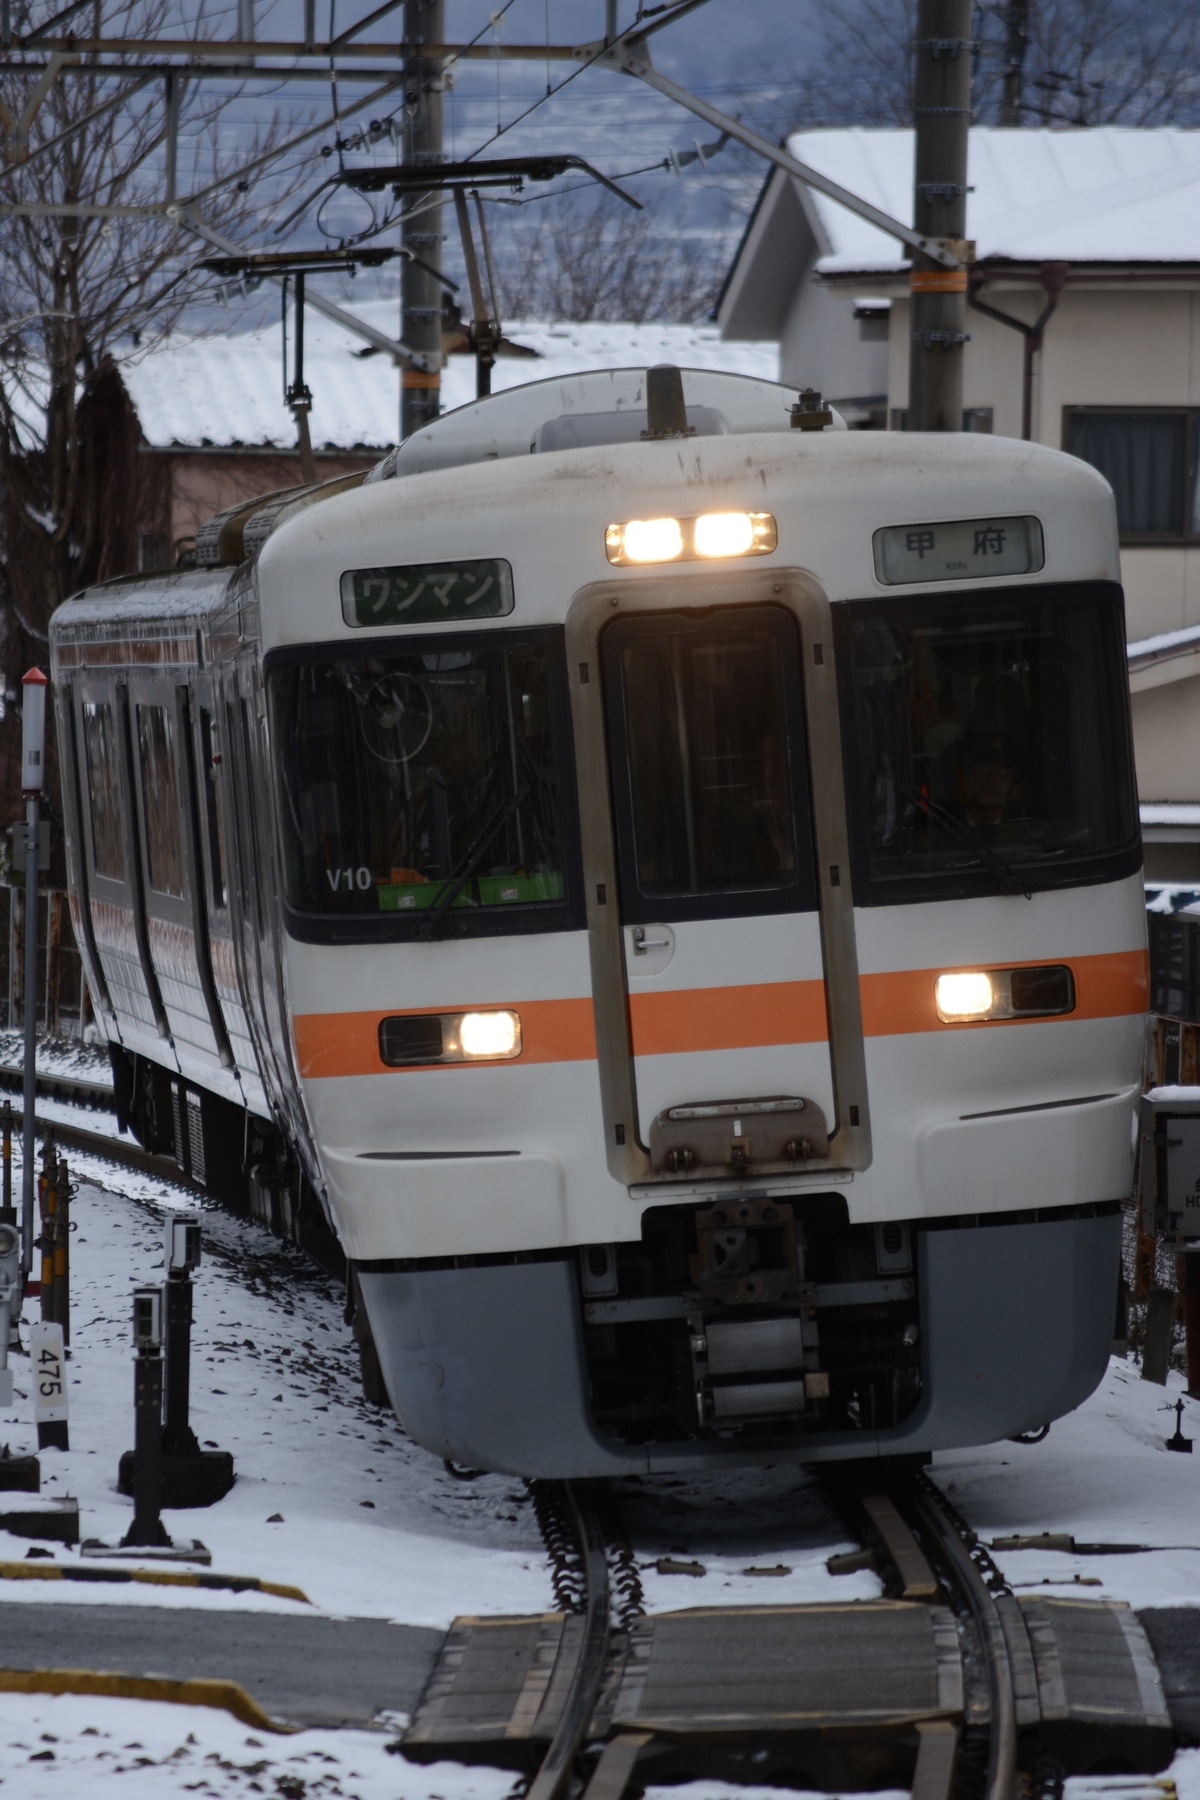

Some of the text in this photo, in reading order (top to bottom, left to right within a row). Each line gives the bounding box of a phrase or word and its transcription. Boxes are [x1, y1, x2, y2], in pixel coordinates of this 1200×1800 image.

[906, 527, 1007, 559] 甲府
[362, 572, 494, 613] ワンマン
[326, 867, 371, 891] V10
[37, 1349, 62, 1397] 475
